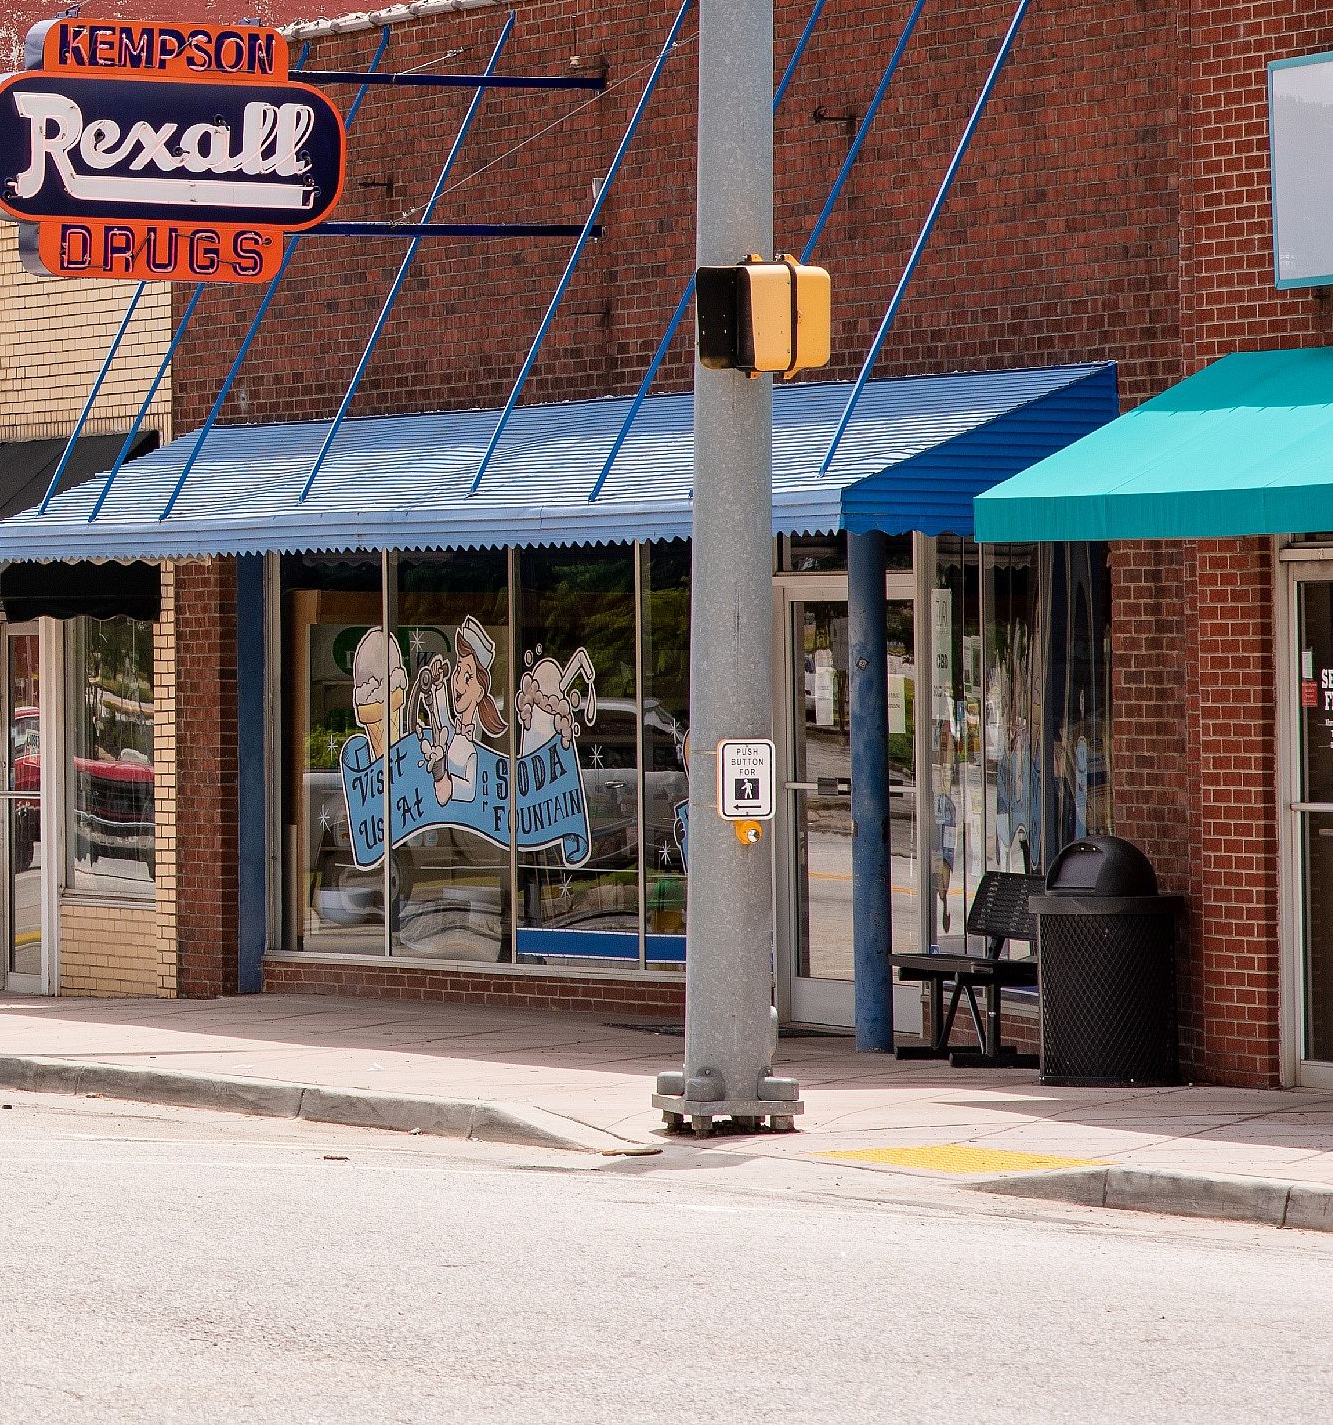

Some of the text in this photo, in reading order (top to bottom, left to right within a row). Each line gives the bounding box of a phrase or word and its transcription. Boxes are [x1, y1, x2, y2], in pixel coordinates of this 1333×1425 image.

[59, 23, 276, 74] KEMPSON
[12, 91, 316, 199] Rexall
[58, 224, 266, 276] DRUGS
[496, 745, 567, 800] SODA
[731, 758, 764, 766] BUTTON
[736, 748, 758, 756] PUSH
[739, 768, 756, 776] FOR
[396, 788, 424, 828] At
